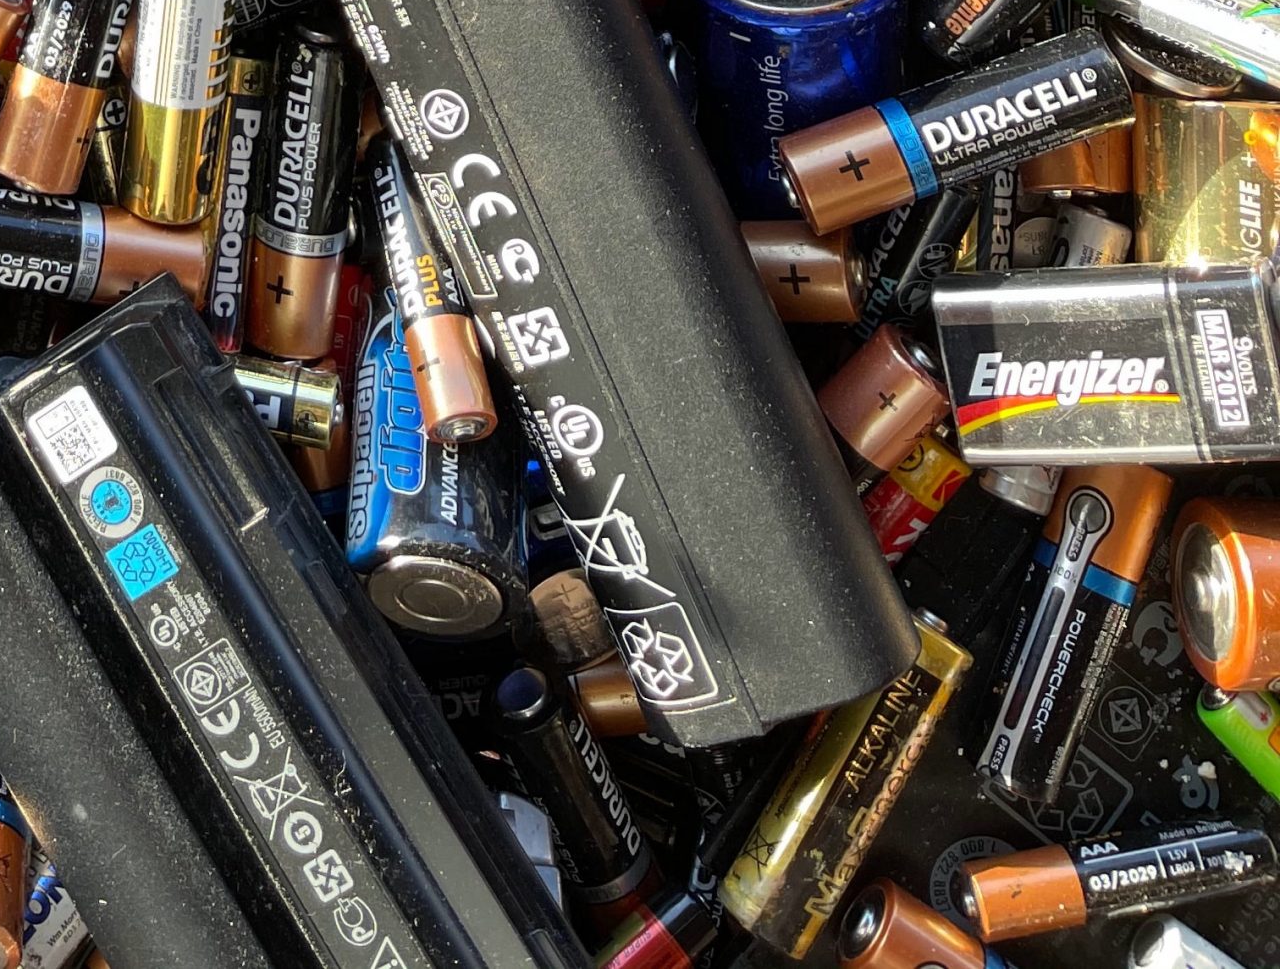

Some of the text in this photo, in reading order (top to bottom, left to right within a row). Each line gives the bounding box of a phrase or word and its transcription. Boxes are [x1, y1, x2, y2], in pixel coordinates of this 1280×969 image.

[43, 0, 74, 69] 03/2029
[764, 54, 789, 135] long life
[933, 113, 1059, 166] ULTRA POWER
[297, 121, 322, 230] PLUS POWER
[212, 106, 262, 319] Panasonic
[20, 255, 74, 275] PLUS
[416, 254, 444, 307] PLUS
[446, 267, 465, 305] AAA
[1201, 313, 1243, 424] MAR 2012
[347, 362, 376, 541] supacell
[531, 407, 565, 461] LISTED
[168, 605, 190, 635] LISTED
[844, 669, 923, 793] ALKALINE
[989, 736, 1008, 773] PRESS
[1080, 840, 1119, 858] AAA
[1088, 867, 1158, 891] 03/2029
